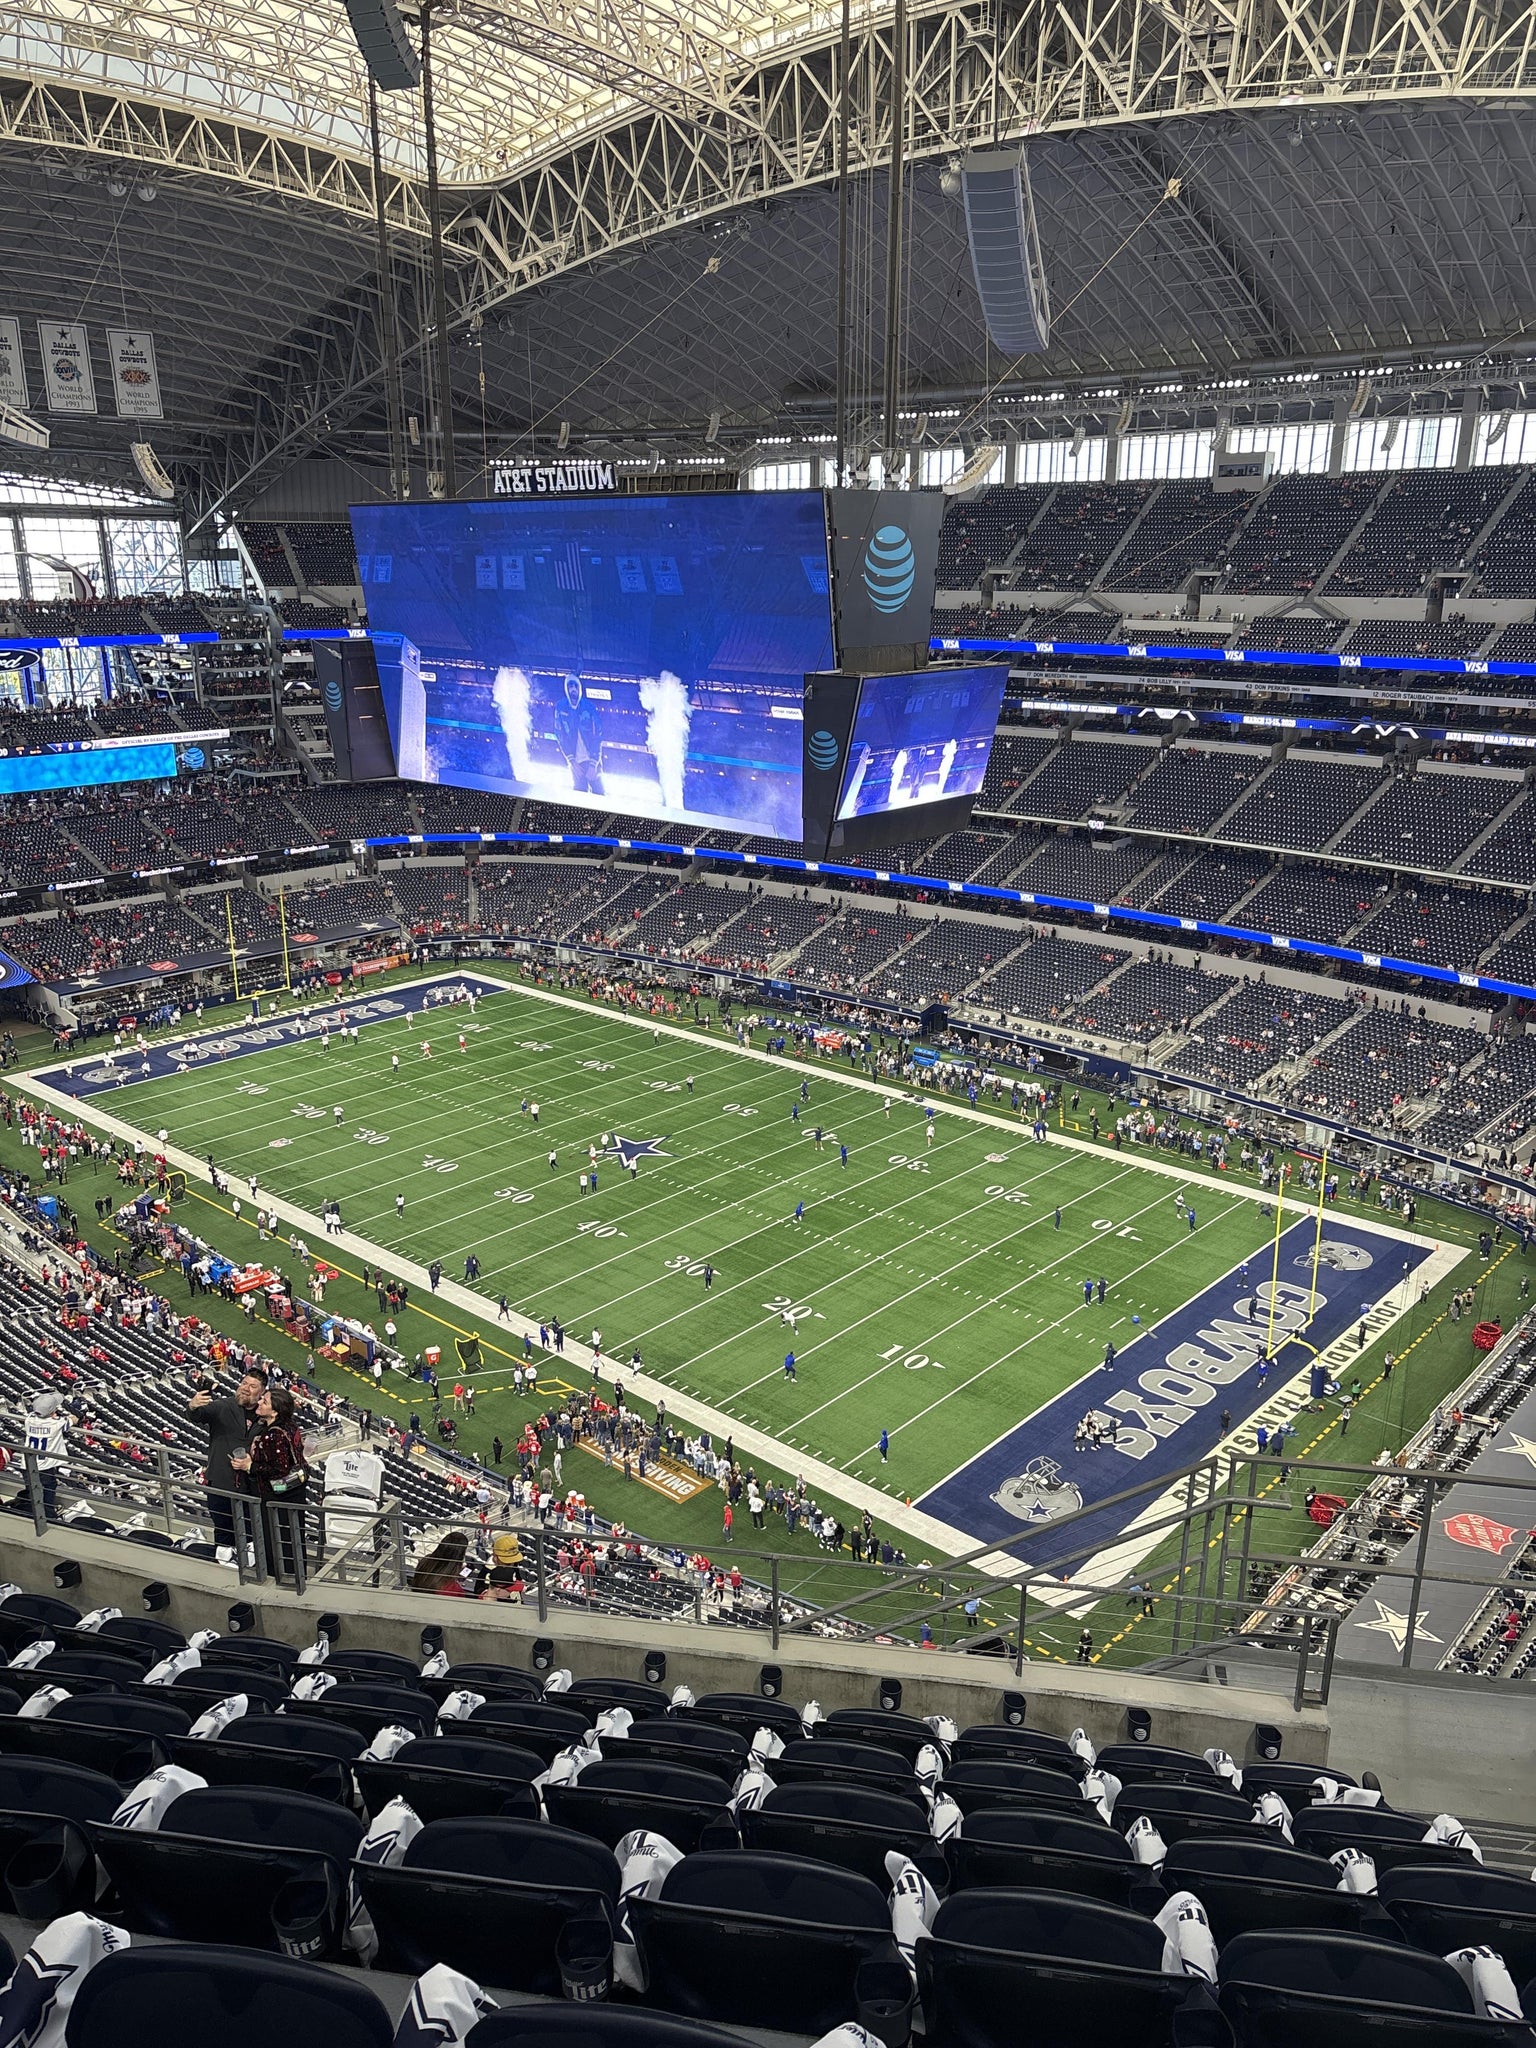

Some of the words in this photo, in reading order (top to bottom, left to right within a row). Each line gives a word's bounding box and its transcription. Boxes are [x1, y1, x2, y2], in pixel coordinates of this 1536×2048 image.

[51, 349, 81, 357] COWBOYS
[121, 349, 144, 357] DALLAS
[119, 356, 148, 364] COWBOYS
[58, 384, 84, 393] WORLD
[51, 391, 92, 401] CHAMPIONS
[126, 391, 150, 399] WORLD
[65, 400, 81, 408] 1993
[120, 398, 158, 407] CHAMPIONS
[494, 467, 532, 494] AT&T
[535, 464, 615, 493] STADIUM
[161, 634, 181, 643] VISA
[347, 629, 368, 638] VISA
[58, 637, 80, 647] VISA
[942, 640, 960, 650] VISA
[1035, 642, 1054, 652] VISA
[1127, 646, 1147, 656] VISA
[1224, 651, 1245, 661] VISA
[0, 651, 24, 669] rd
[1338, 656, 1362, 667] VISA
[1464, 661, 1489, 673] VISA
[1403, 693, 1434, 701] STAUBACH
[1485, 734, 1508, 744] GRAND
[1508, 736, 1526, 747] PRIX
[290, 843, 330, 856] Blockchain.com
[217, 853, 259, 866] Blockchain.com
[140, 865, 185, 878] Blockchain.com
[876, 872, 890, 881] VISA
[56, 877, 105, 891] Blockchain.com
[949, 882, 963, 892] VISA
[1020, 892, 1036, 903] VISA
[1094, 904, 1110, 915] VISA
[1180, 919, 1198, 931] VISA
[1271, 936, 1290, 948] VISA
[1362, 954, 1381, 967] VISA
[1458, 974, 1480, 988] VISA
[167, 1000, 405, 1061] COWBOYS
[236, 1080, 269, 1096] 10
[291, 1106, 327, 1119] 20
[722, 1103, 759, 1118] 50
[353, 1130, 391, 1145] 30
[421, 1157, 459, 1174] 40
[888, 1153, 929, 1172] 30
[493, 1187, 535, 1204] 50
[984, 1185, 1030, 1203] 20
[576, 1220, 618, 1239] 40
[664, 1255, 711, 1277] 30
[762, 1296, 813, 1320] 20
[877, 1343, 930, 1370] 10
[1297, 1331, 1370, 1386] MADDN
[1087, 1281, 1328, 1460] COWBOYS
[345, 1461, 359, 1472] Lite
[569, 1978, 608, 2003] Lite
